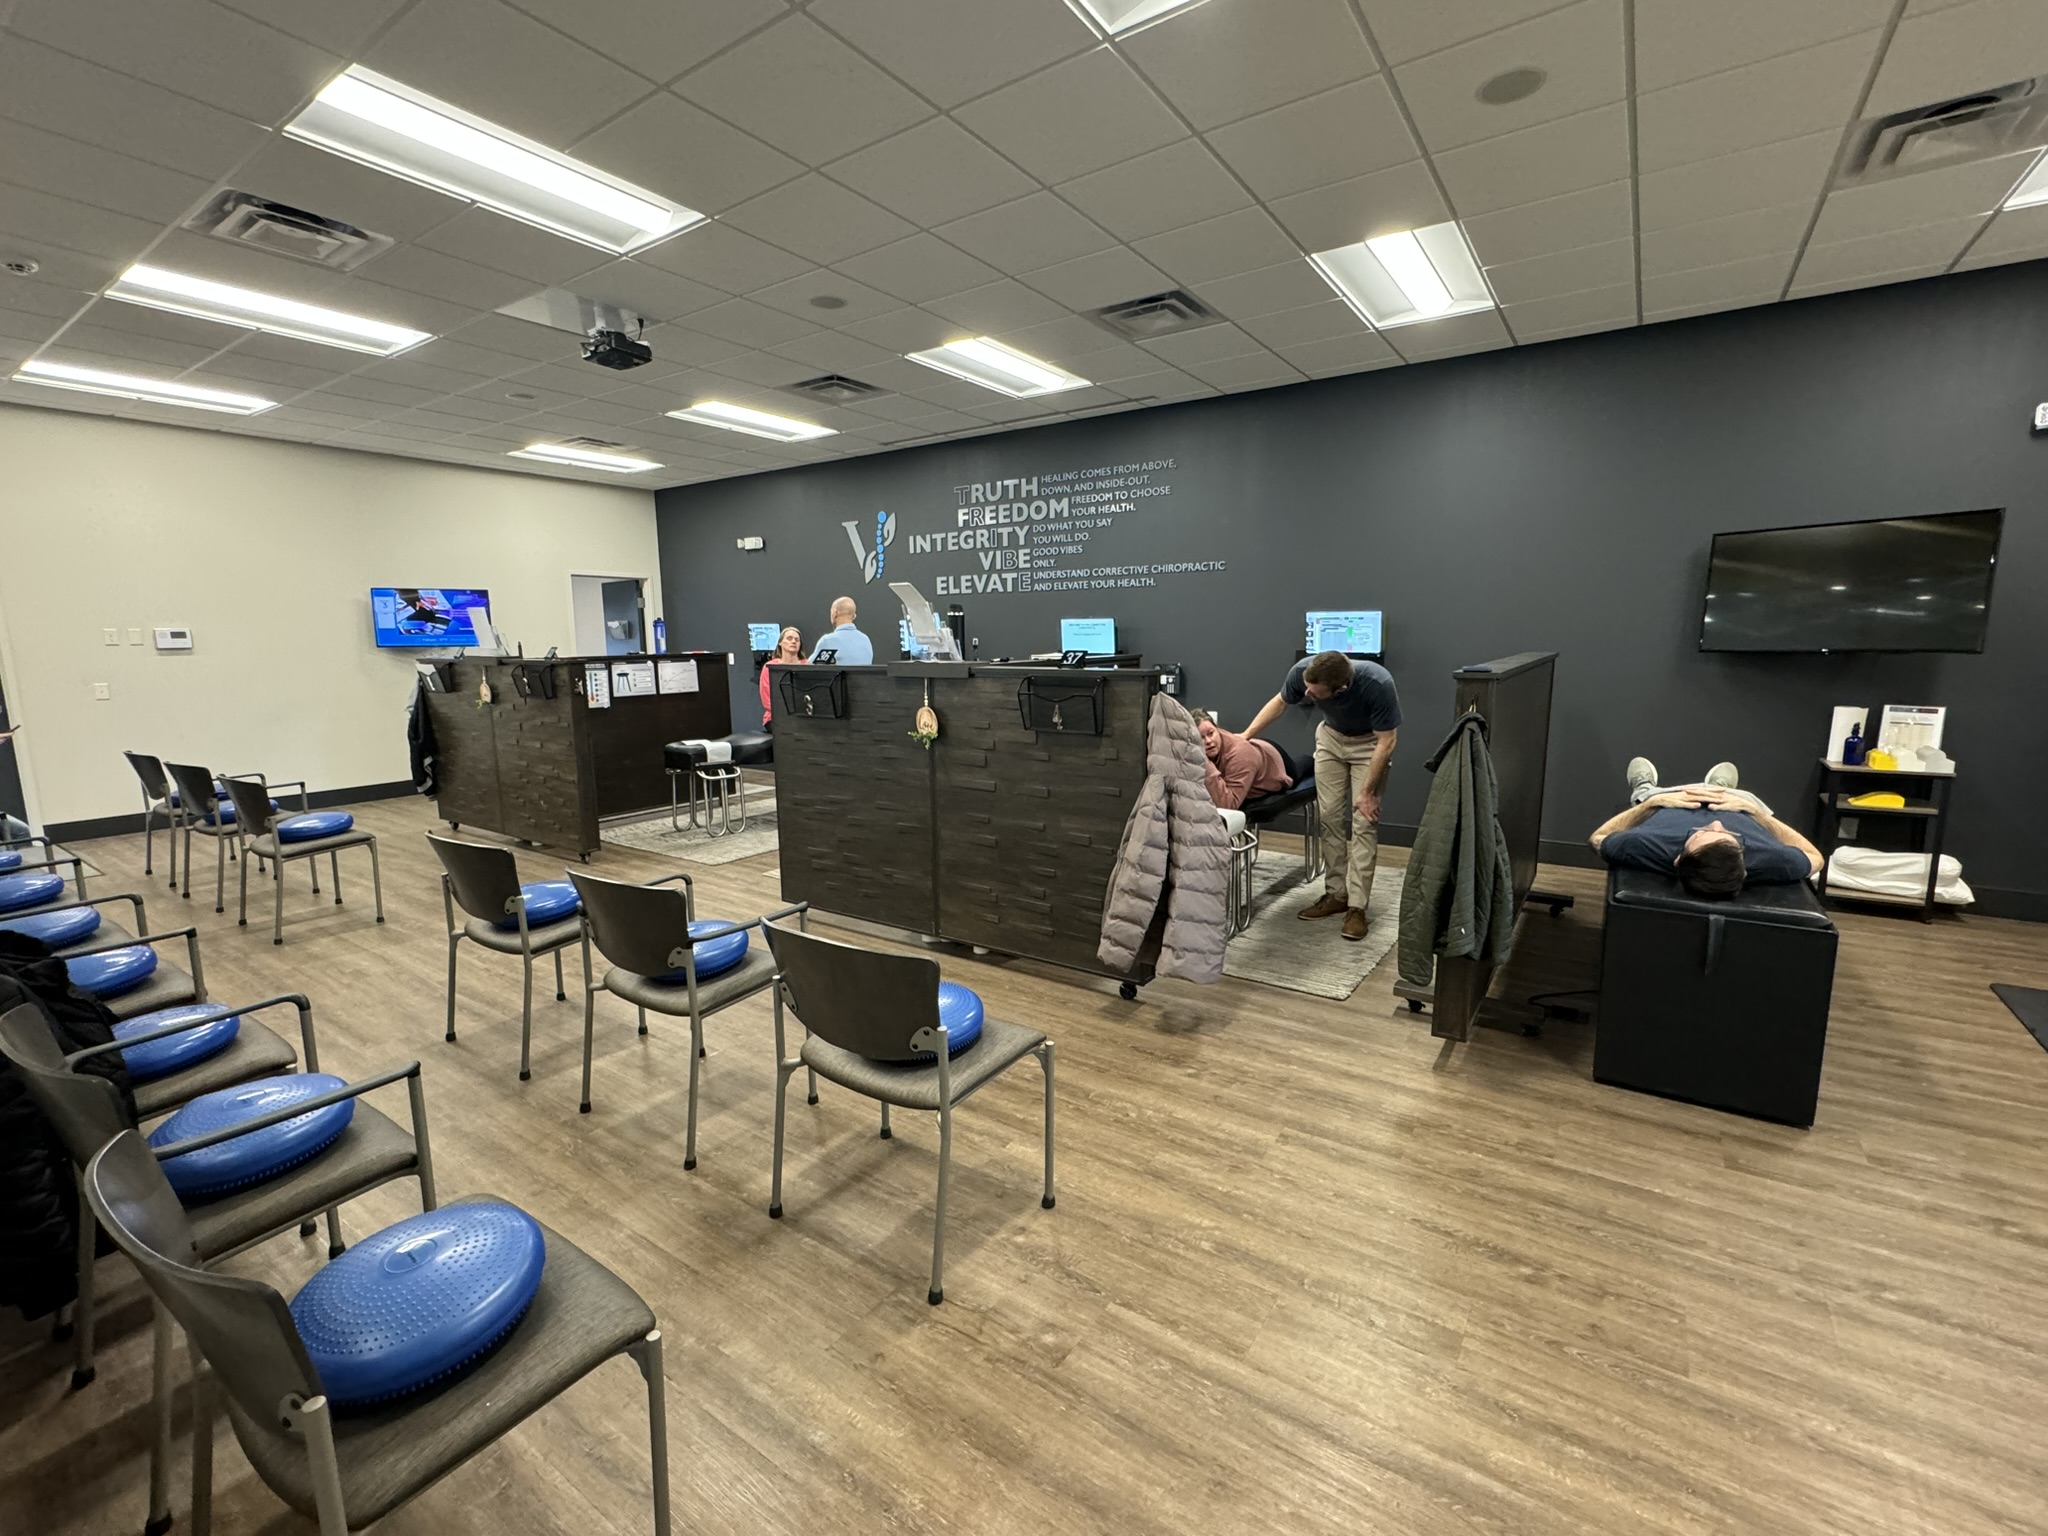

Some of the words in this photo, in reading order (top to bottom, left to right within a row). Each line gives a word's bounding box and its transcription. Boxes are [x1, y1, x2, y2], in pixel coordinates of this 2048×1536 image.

[1041, 471, 1079, 484] HEALING
[1080, 467, 1112, 479] COMES
[1113, 463, 1140, 475] FROM
[954, 476, 1039, 505] TRUTH
[1071, 492, 1113, 505] FREEDOM
[1114, 490, 1129, 501] TO
[1130, 485, 1172, 498] CHOOSE
[1074, 482, 1095, 492] AND
[957, 497, 1070, 528] FREEDOM
[1071, 506, 1097, 517] YOUR
[1098, 502, 1136, 514] HEALTH.
[1032, 524, 1047, 533] DO
[1047, 521, 1073, 532] WHAT
[1075, 519, 1095, 529] YOU
[1096, 518, 1113, 528] SAY
[908, 525, 1030, 554] INTEGRITY
[1032, 536, 1052, 545] YOU
[1052, 533, 1074, 543] WILL
[1074, 532, 1092, 542] DO.
[1032, 547, 1060, 557] GOOD
[1060, 545, 1083, 555] VIBES
[979, 549, 1031, 571] VIBE
[1032, 559, 1057, 569] ONLY.
[1033, 569, 1091, 580] UNDERSTAND
[1091, 565, 1149, 577] CORRECTIVE
[1151, 560, 1226, 574] CHIROPRACTIC
[936, 572, 1032, 596] ELEVATE
[1033, 582, 1053, 592] AND
[1053, 580, 1090, 590] ELEVATE
[1090, 579, 1116, 589] YOUR
[1117, 577, 1156, 588] HEALTH.
[818, 651, 832, 662] 36
[1063, 651, 1084, 664] 37
[804, 694, 814, 717] 3
